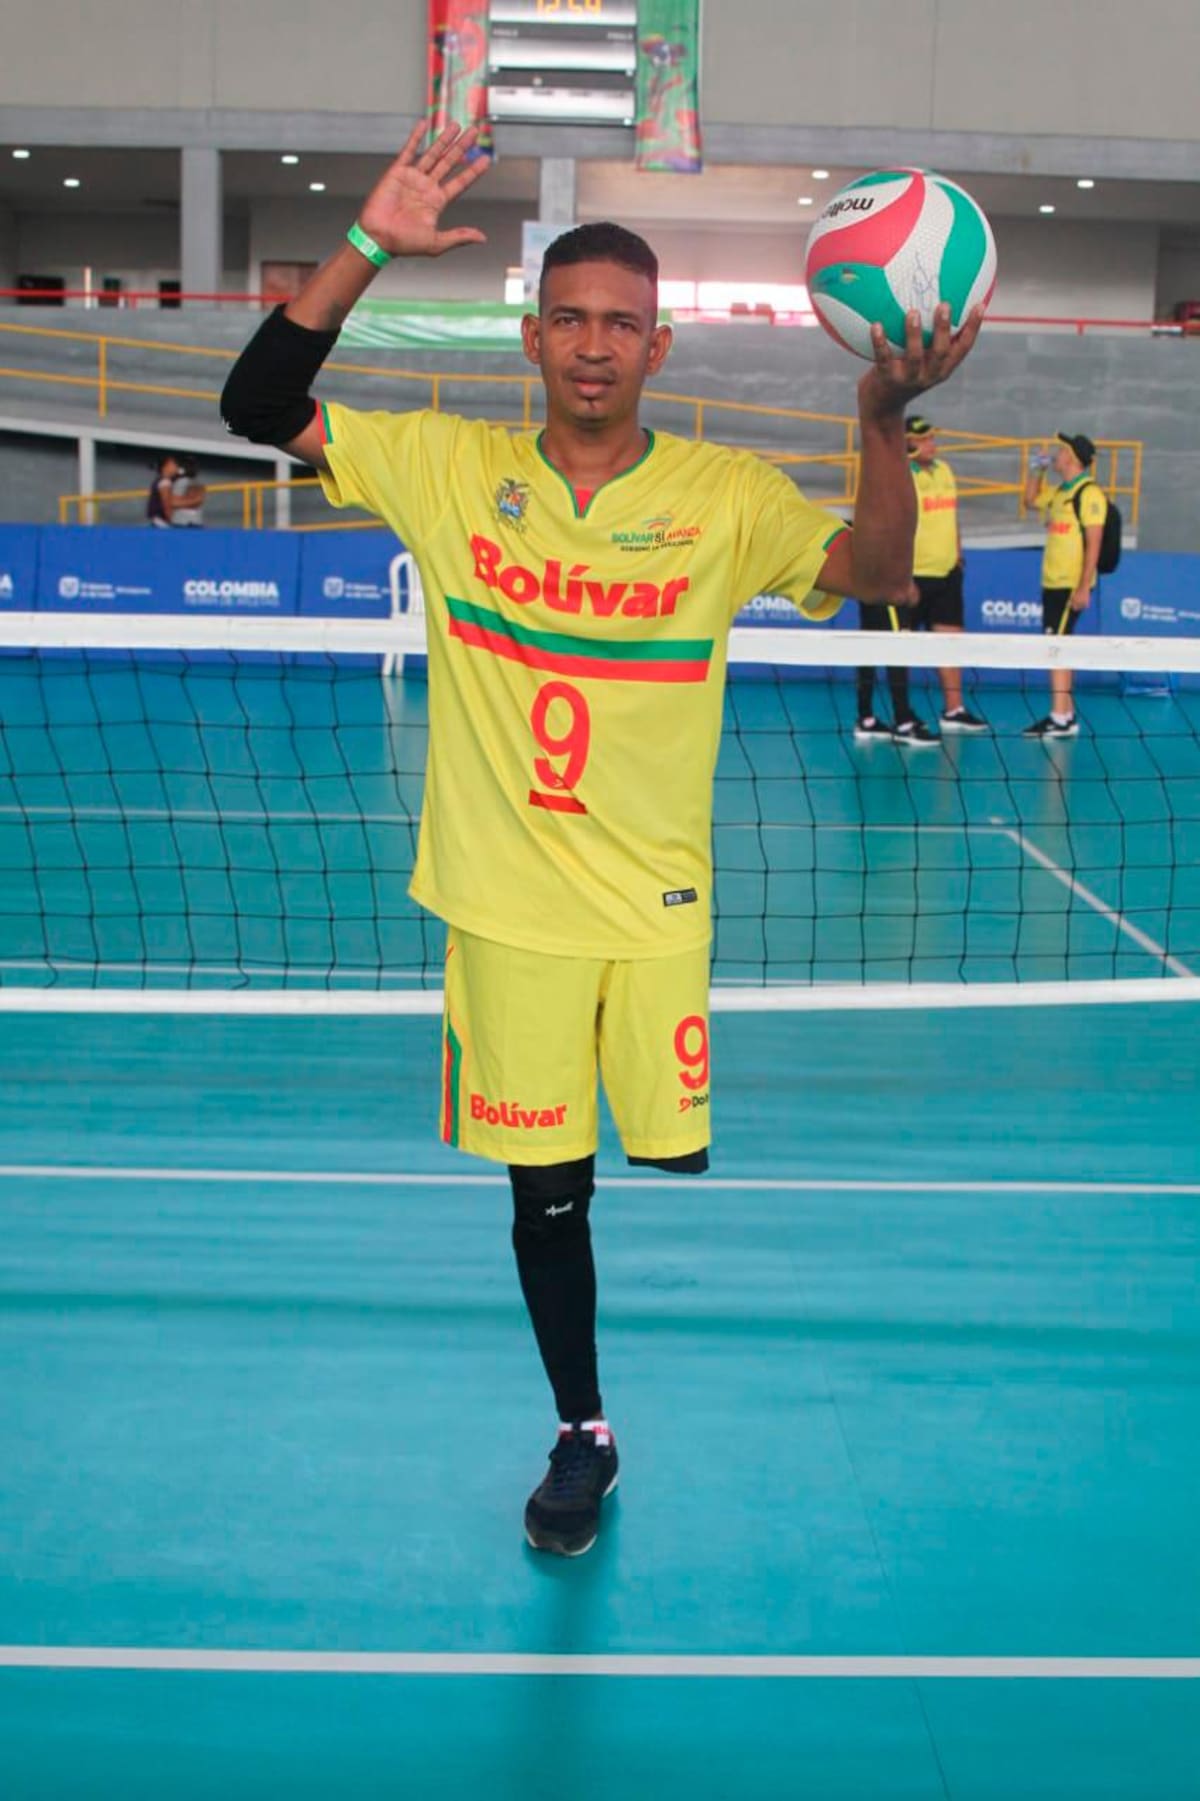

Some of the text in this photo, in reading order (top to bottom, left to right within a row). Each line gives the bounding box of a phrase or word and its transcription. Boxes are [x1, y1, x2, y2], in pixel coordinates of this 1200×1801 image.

[184, 580, 279, 597] COLOMBIA
[470, 533, 689, 618] Bolívar
[981, 600, 1043, 618] COLOM
[530, 680, 591, 790] 9
[674, 1015, 709, 1090] 9
[470, 1094, 567, 1129] Bolívar
